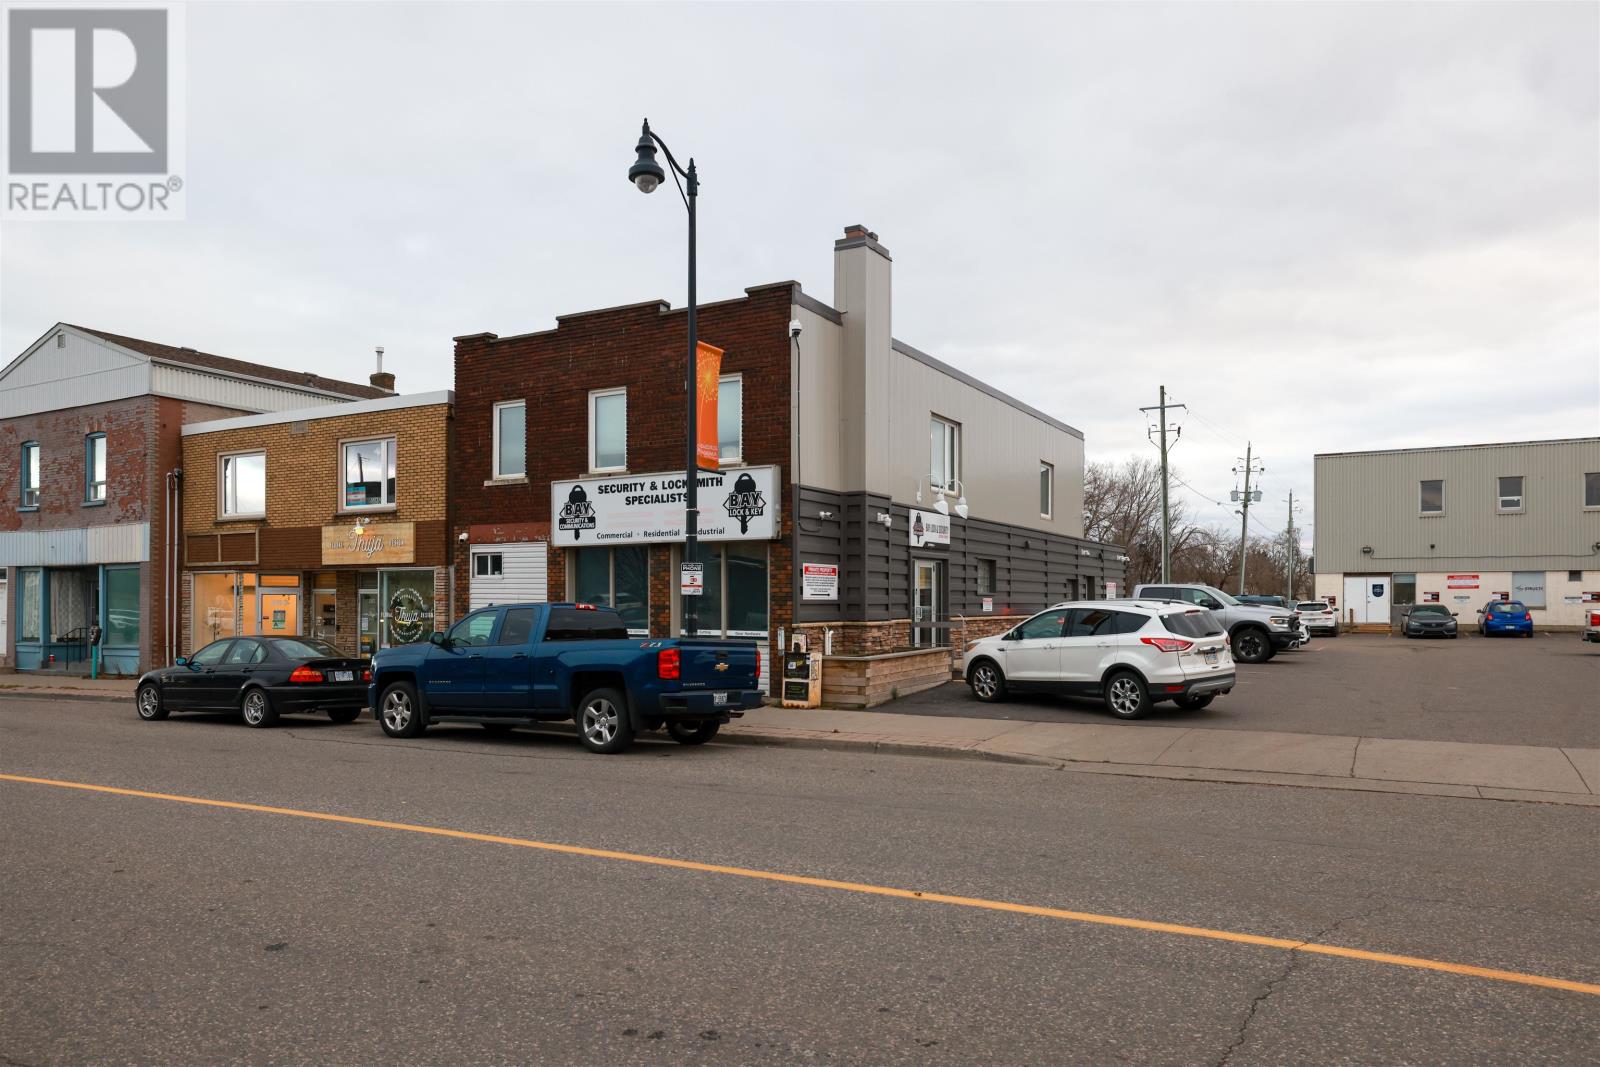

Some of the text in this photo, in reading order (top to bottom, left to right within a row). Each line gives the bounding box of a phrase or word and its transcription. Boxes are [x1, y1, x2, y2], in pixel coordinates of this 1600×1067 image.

[598, 477, 723, 494] SECURITY & LOCKMITH
[625, 493, 687, 505] SPECIALISTS
[729, 491, 762, 508] BAY
[564, 501, 592, 517] BAY
[730, 508, 744, 516] LOCK
[596, 531, 633, 540] Commercial
[643, 529, 680, 538] Residential
[347, 529, 385, 558] Thuja
[395, 606, 419, 627] Thuja
